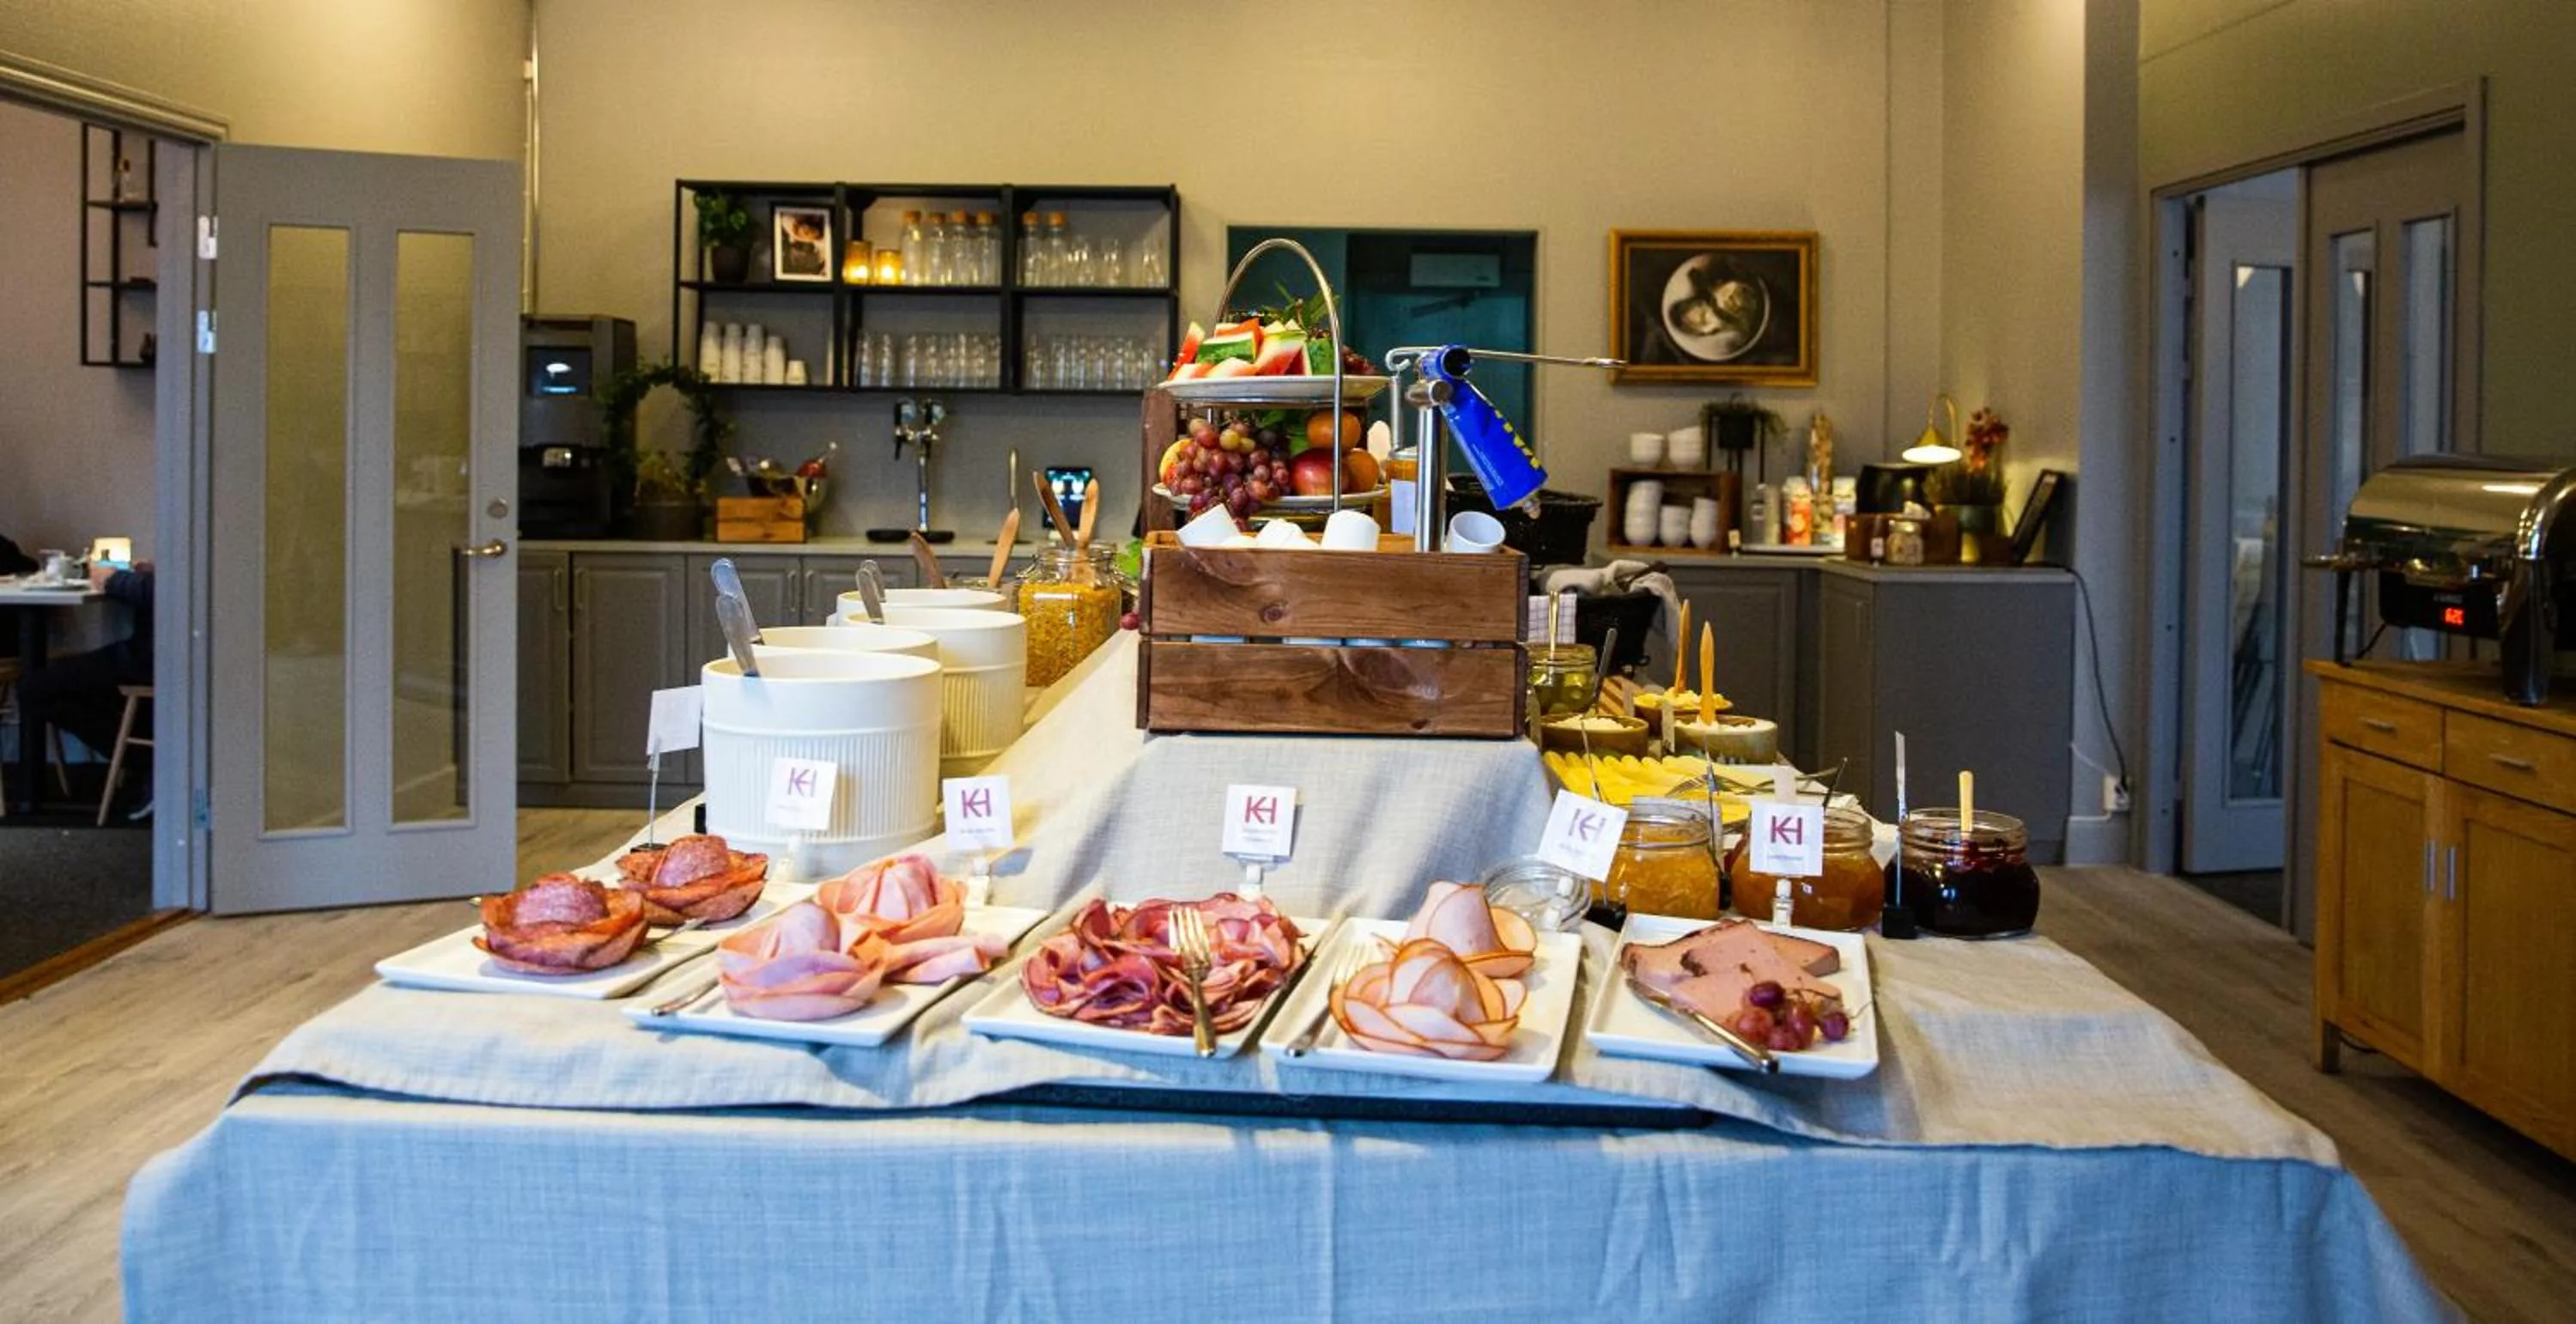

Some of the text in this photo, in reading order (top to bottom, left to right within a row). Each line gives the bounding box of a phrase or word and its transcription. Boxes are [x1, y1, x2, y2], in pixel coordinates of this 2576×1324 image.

[961, 788, 992, 818] KH
[1245, 796, 1277, 824] KH
[1771, 815, 1802, 846] KH
